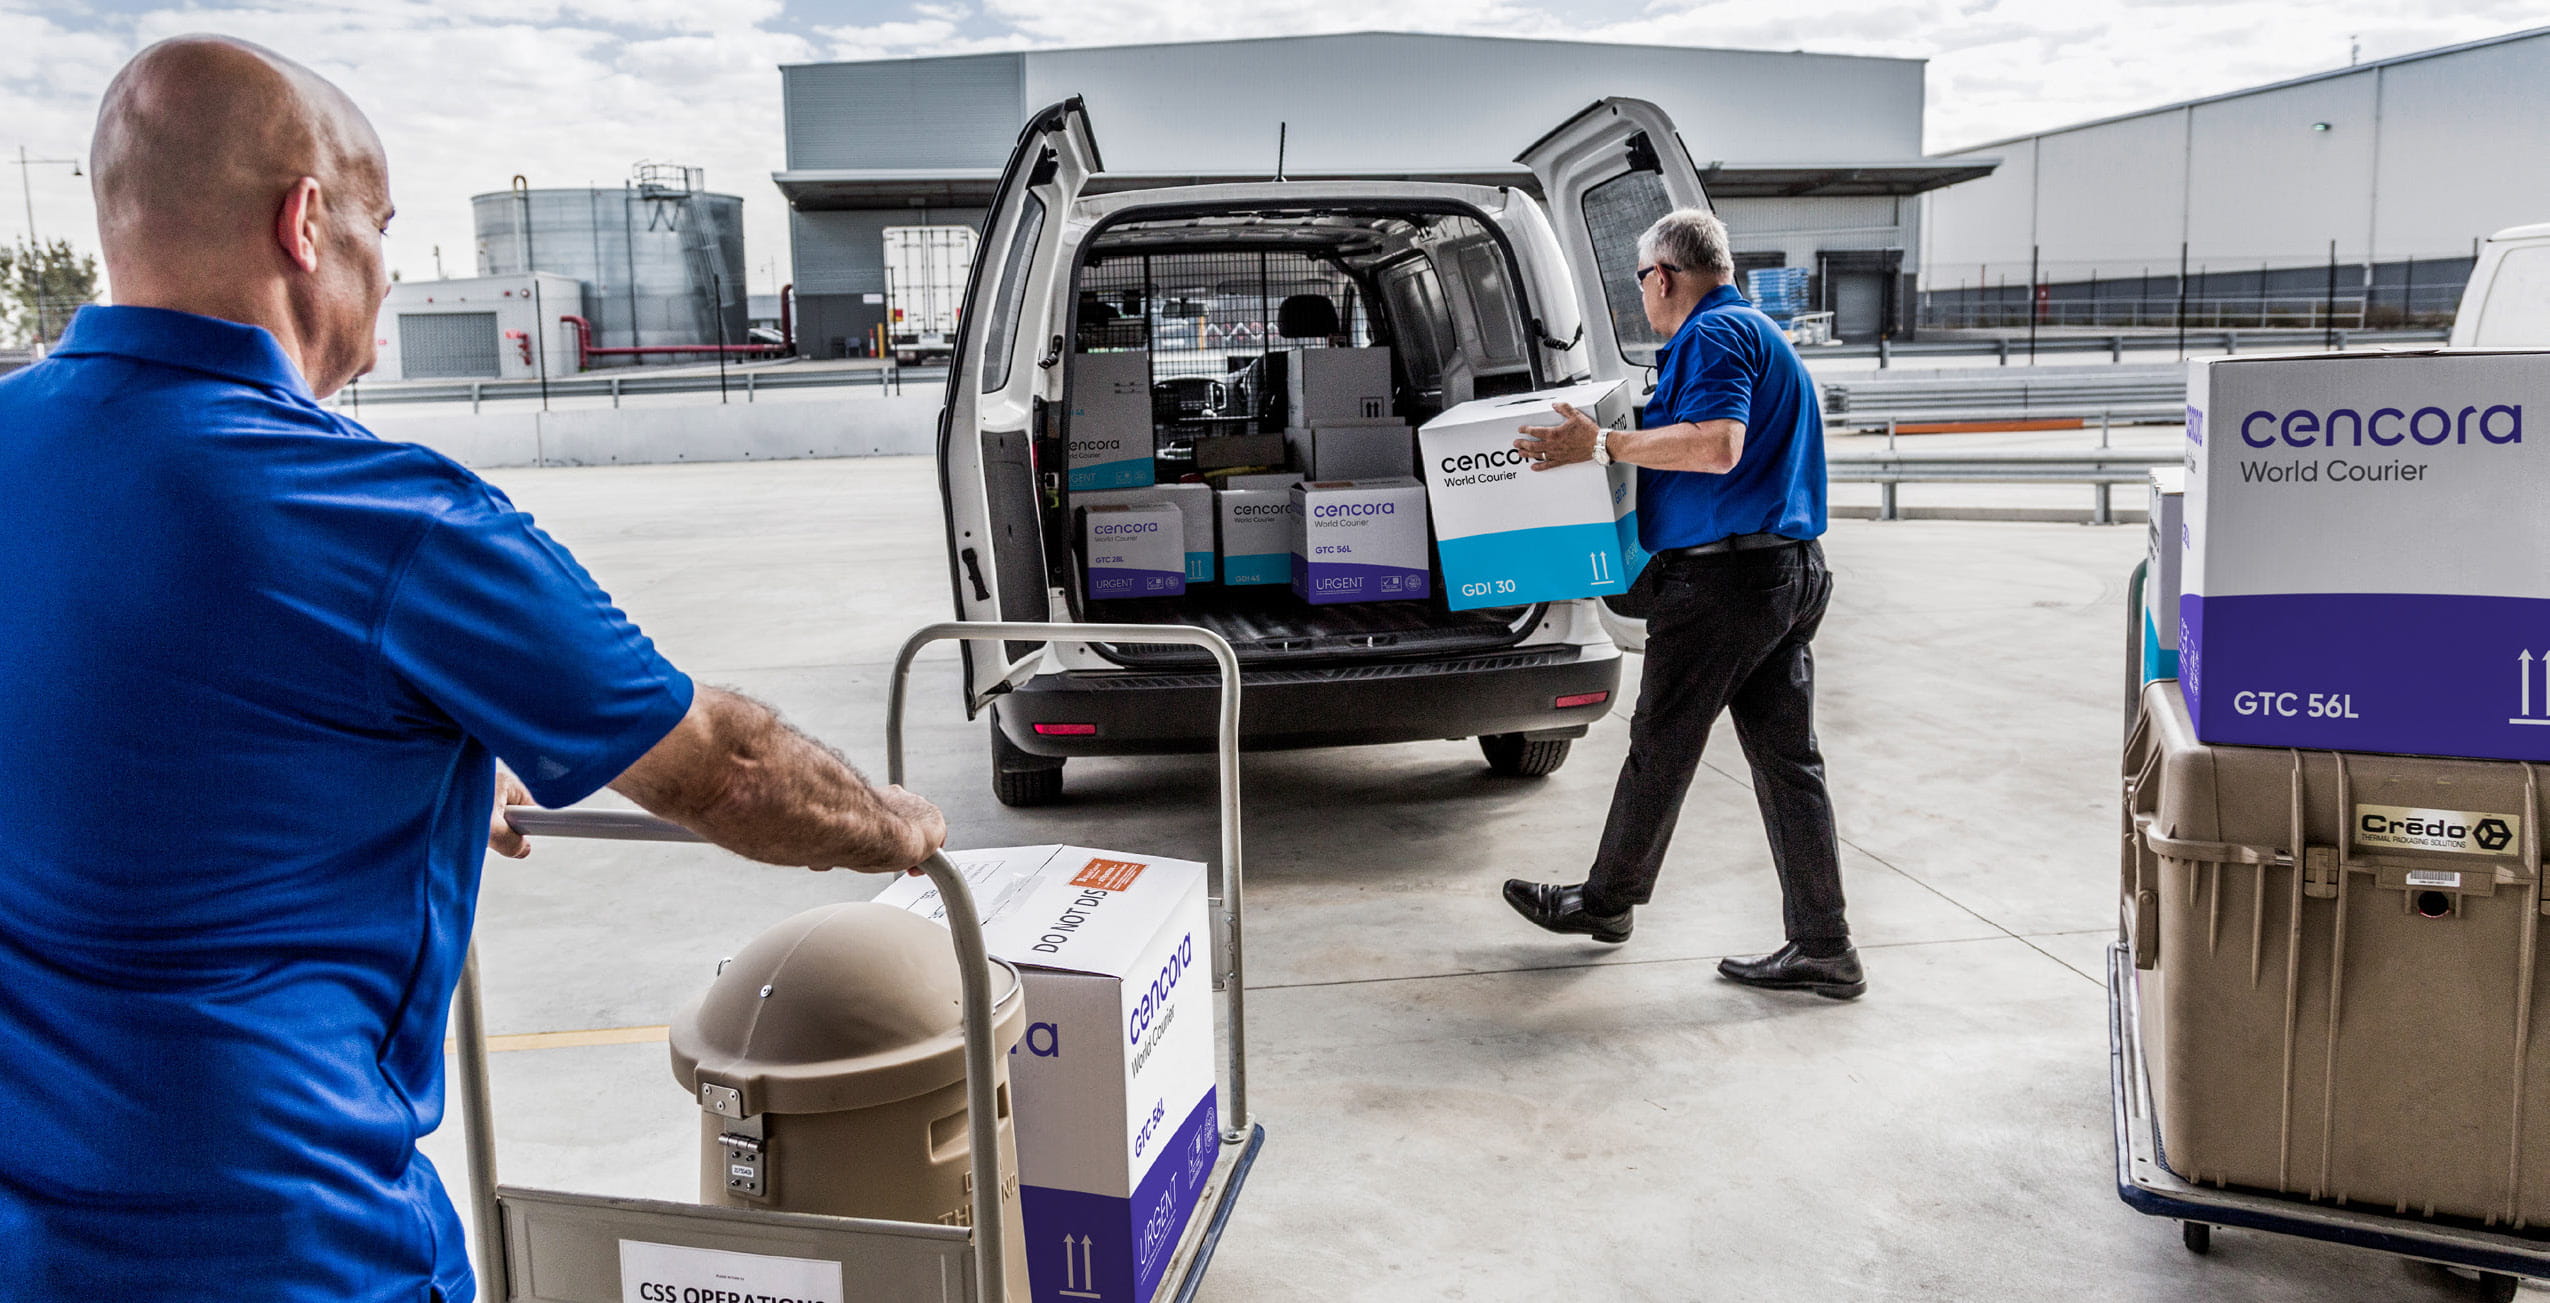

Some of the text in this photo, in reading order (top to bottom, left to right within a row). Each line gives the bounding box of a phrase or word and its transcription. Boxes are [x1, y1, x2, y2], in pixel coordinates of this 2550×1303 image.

[2241, 404, 2522, 448] cencora
[1069, 440, 1120, 452] encora
[1441, 448, 1546, 473] cenco
[1069, 472, 1096, 483] GENT
[1444, 471, 1517, 488] World Courier
[2241, 459, 2428, 483] World Courier
[1314, 502, 1395, 518] cencora
[1094, 522, 1158, 535] cencora
[1315, 519, 1369, 528] World Courier
[1315, 545, 1352, 554] GTC 56L
[1095, 556, 1111, 564] GTC
[1096, 578, 1134, 589] URGENT
[1316, 577, 1364, 590] URGENT
[1462, 579, 1516, 597] GDI 30
[2233, 690, 2359, 719] GTC 56L
[2361, 833, 2467, 849] THERMAL PACKAGING SOLUTIONS
[1031, 934, 1068, 954] DO
[1050, 907, 1092, 933] NOT
[1130, 932, 1191, 1045] cencora
[1131, 1004, 1175, 1079] World Courier
[1135, 1097, 1165, 1158] GTC 56L
[1139, 1171, 1178, 1265] URGENT
[640, 1282, 825, 1303] CSS OPERA
